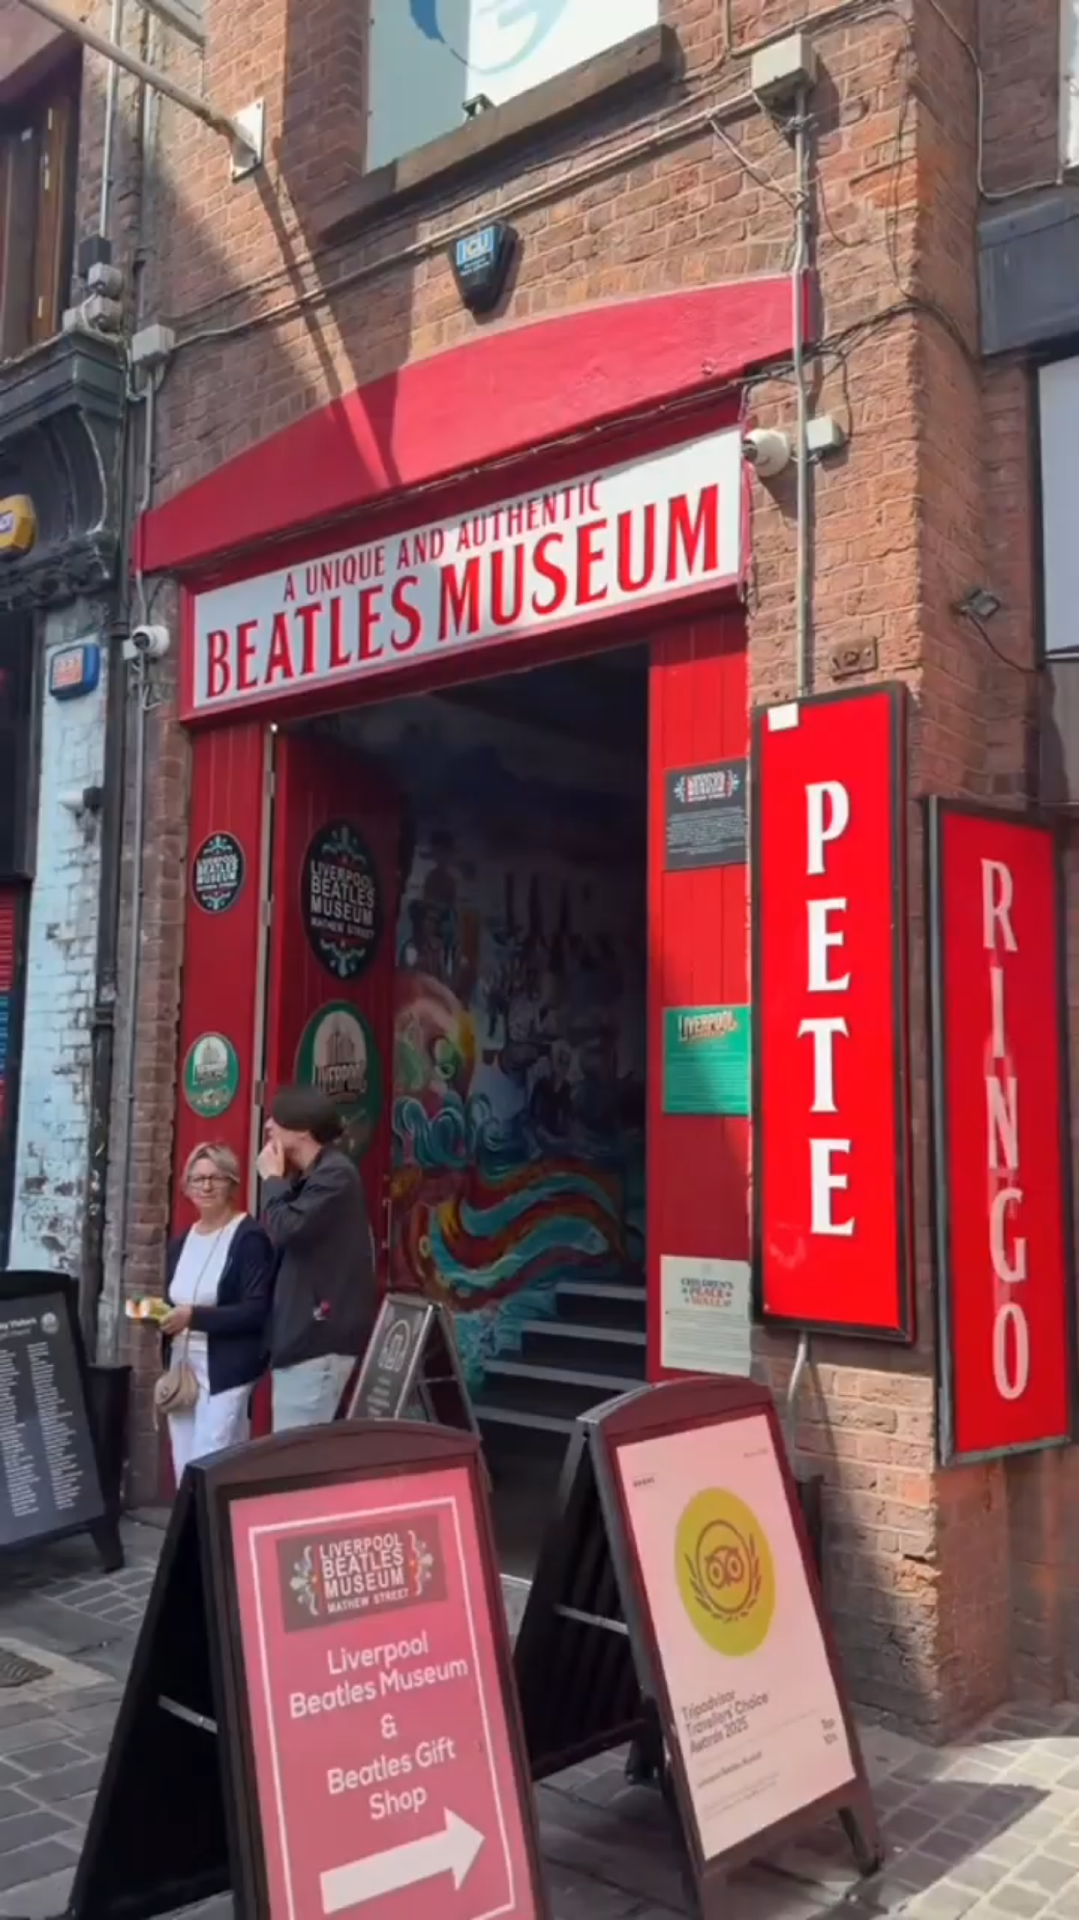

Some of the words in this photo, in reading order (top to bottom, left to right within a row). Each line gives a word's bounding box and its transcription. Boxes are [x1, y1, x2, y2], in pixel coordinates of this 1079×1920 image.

[283, 573, 296, 601] A
[305, 546, 386, 597] UNIQUE
[397, 528, 445, 570] AND
[456, 479, 602, 553] AUTHENTIC
[205, 575, 421, 698] BEATLES
[438, 483, 720, 642] MUSEUM
[311, 875, 375, 909] BEATLES
[310, 894, 373, 926] MUSEUM
[798, 780, 855, 1236] PETE
[980, 858, 1030, 1399] RINGO
[319, 1532, 403, 1560] LIVERPOOL
[322, 1548, 404, 1580] BEATLES
[324, 1566, 405, 1600] MUSEUM
[327, 1596, 370, 1614] MATHEW
[373, 1588, 409, 1605] STREET
[327, 1629, 429, 1675] Liverpool
[289, 1681, 377, 1720] Beatles
[379, 1658, 468, 1697] Museum
[682, 1690, 736, 1720] Tripadvisor
[381, 1713, 398, 1739] &
[724, 1715, 750, 1739] 2025
[327, 1754, 413, 1795] Beatles
[415, 1736, 456, 1768] Gift
[369, 1786, 427, 1821] Shop
